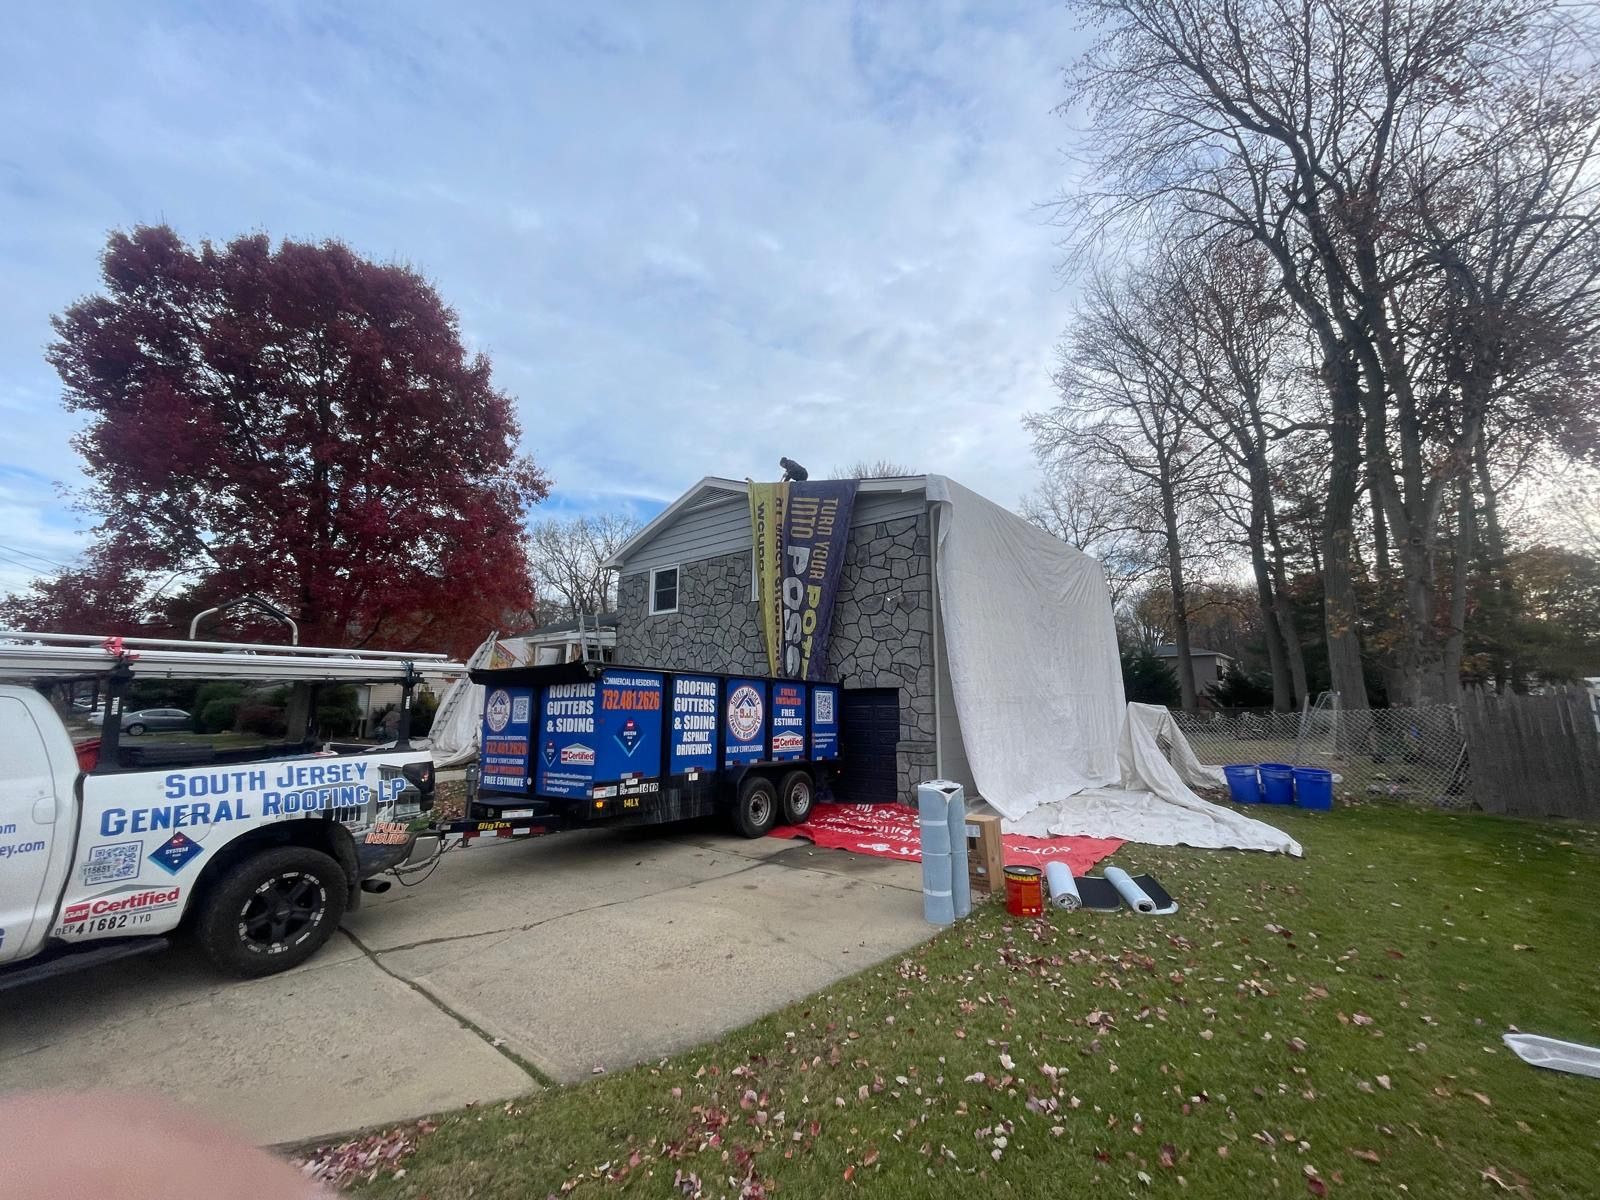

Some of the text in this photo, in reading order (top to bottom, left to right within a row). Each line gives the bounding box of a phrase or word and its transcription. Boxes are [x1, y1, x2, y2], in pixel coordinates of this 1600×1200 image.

[791, 497, 820, 539] INTO
[816, 498, 839, 536] TURN
[809, 541, 830, 581] YOUR
[549, 683, 596, 699] ROOFING
[676, 680, 716, 696] ROOFING
[602, 689, 660, 709] 732.481.2626
[674, 697, 715, 713] GUTTERS
[547, 700, 594, 716] GUTTERS
[781, 709, 796, 717] FREE
[547, 718, 594, 733] & SIDING
[674, 715, 715, 730] & SIDING
[774, 717, 803, 726] ESTIMATE
[682, 731, 709, 742] ASPHALT
[780, 738, 803, 747] Certified
[568, 751, 594, 761] Certified
[676, 743, 712, 756] DRIVEWAYS
[165, 762, 368, 800] SOUTH JERSEY
[483, 776, 524, 787] FREE ESTIMATE
[100, 777, 407, 836] GENERAL ROOFING LP
[375, 822, 410, 833] FULLY
[92, 887, 180, 915] Certified
[75, 914, 128, 936] 41682
